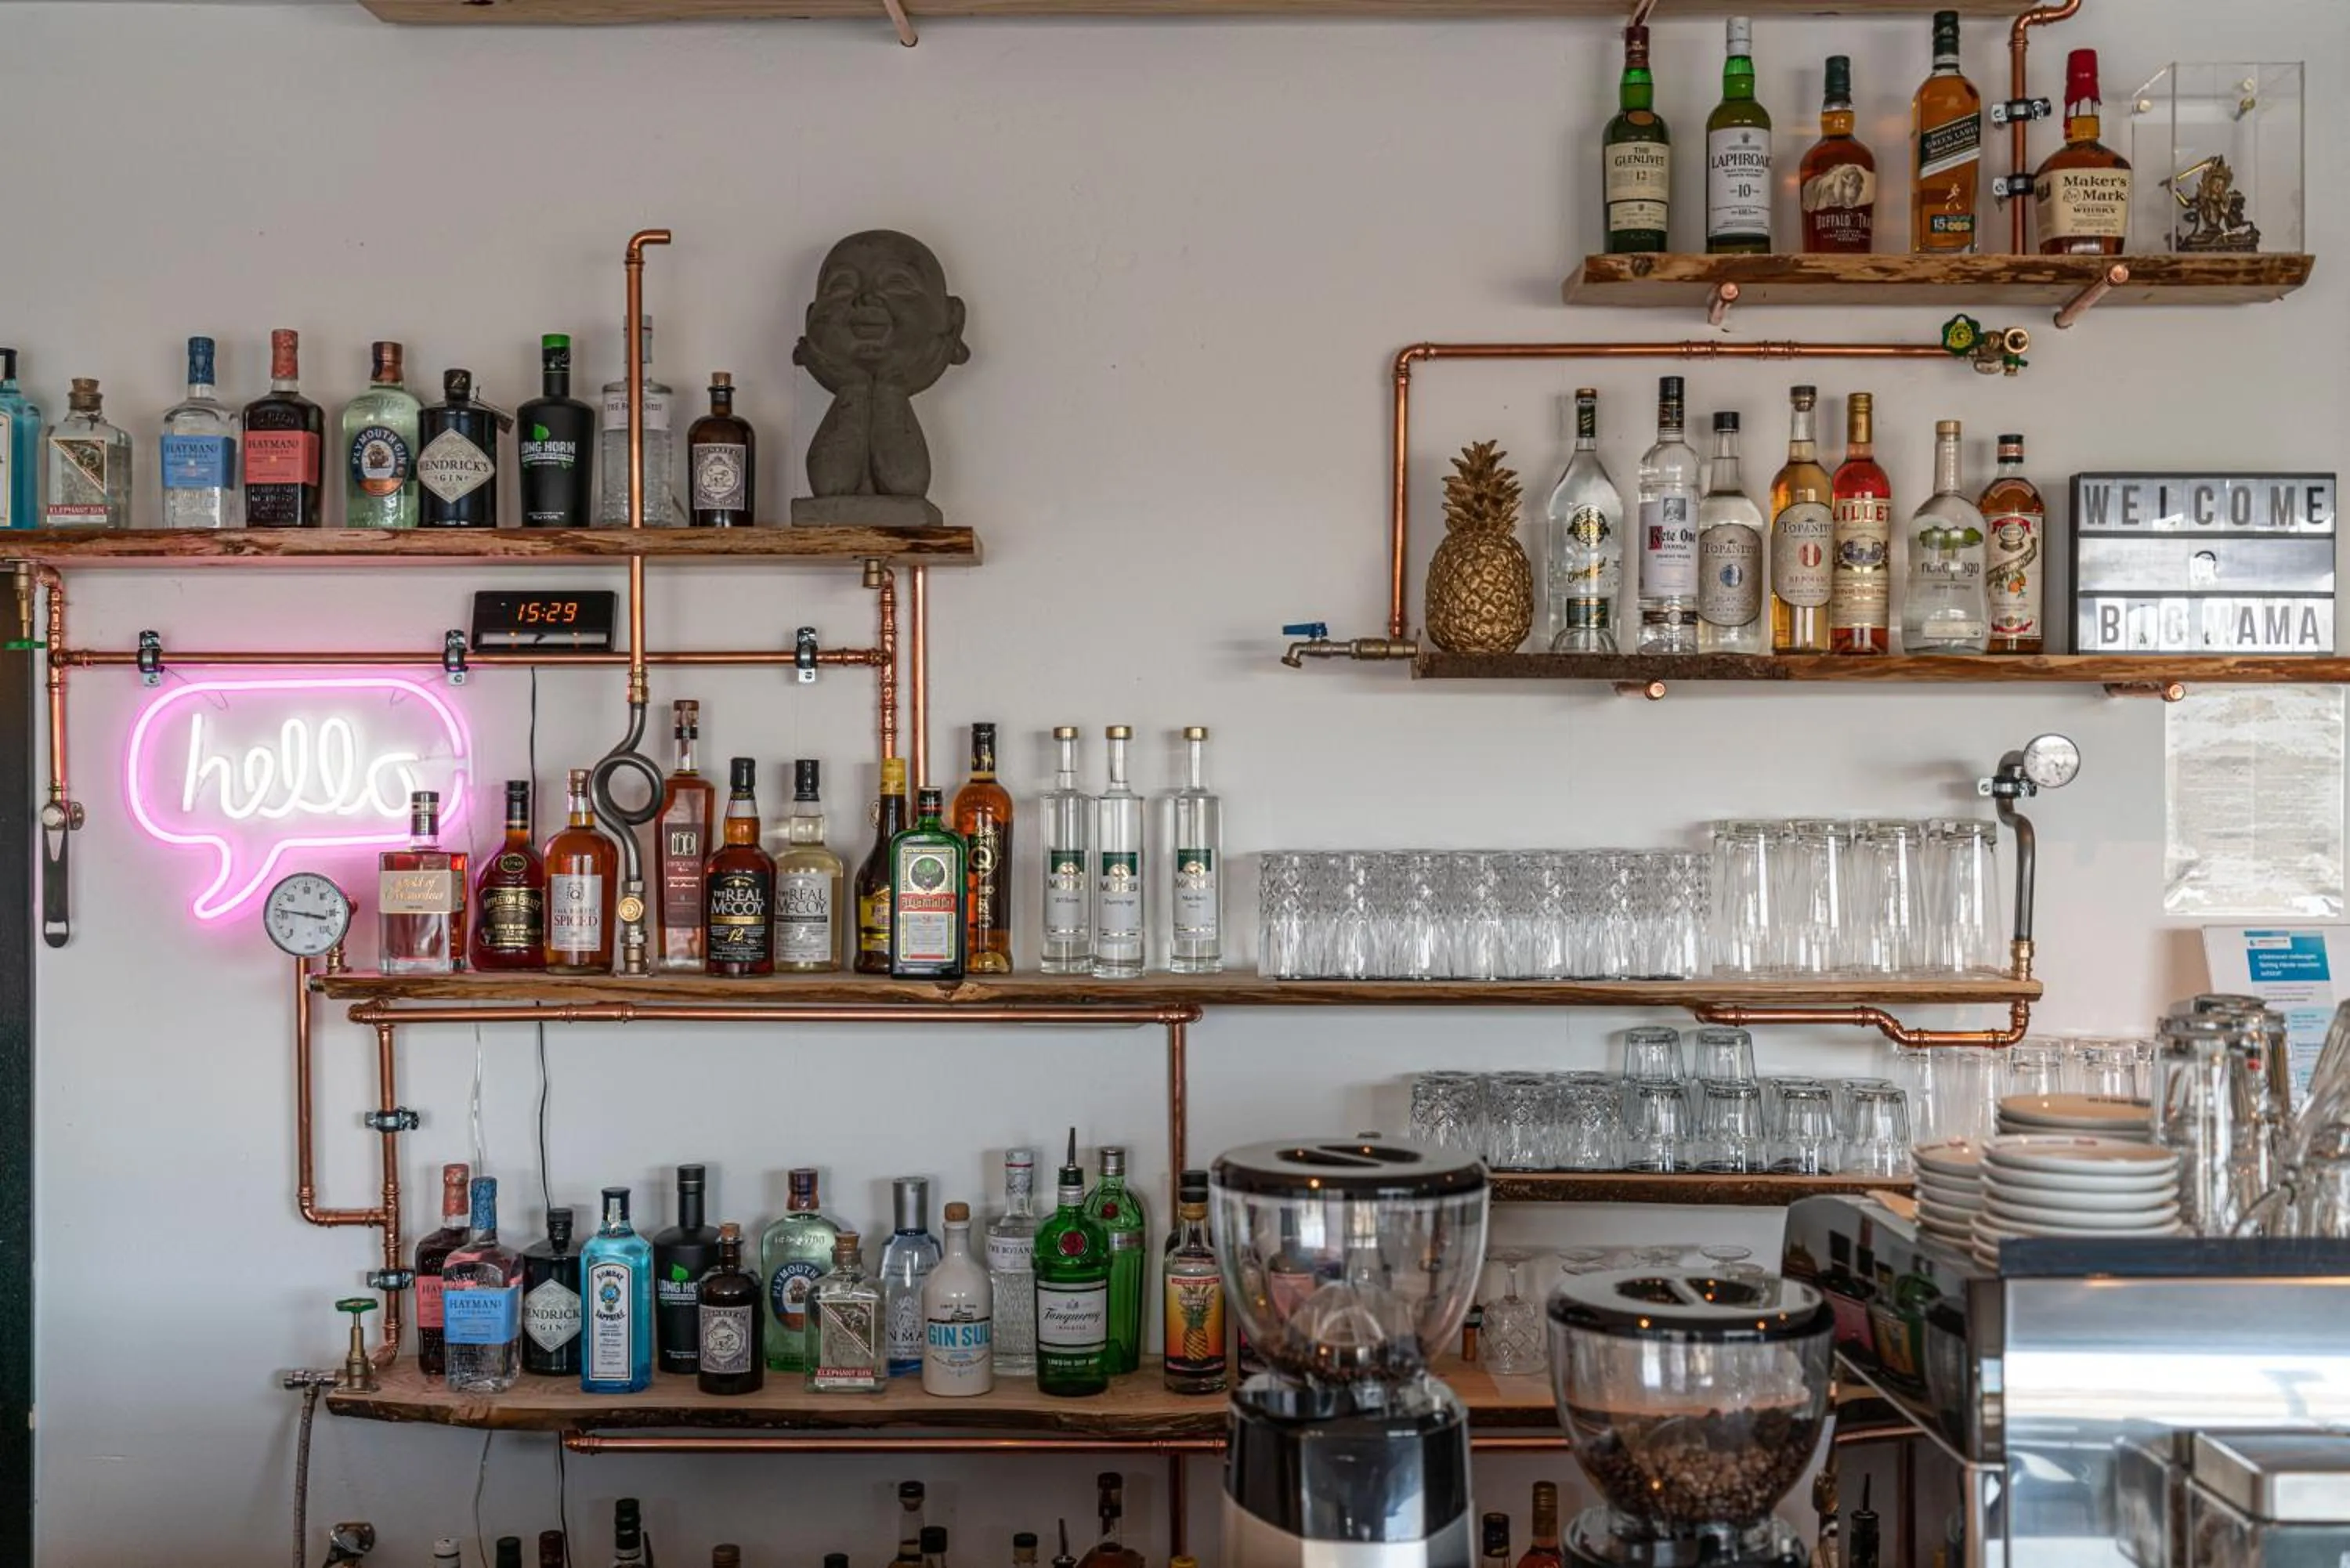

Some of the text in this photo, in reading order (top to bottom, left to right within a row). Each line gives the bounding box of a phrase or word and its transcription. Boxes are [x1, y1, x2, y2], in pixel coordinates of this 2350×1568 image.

[1614, 155, 1665, 167] GLENLIVET
[1636, 172, 1647, 181] 12
[2063, 175, 2128, 188] Maker's
[1737, 184, 1752, 198] 10
[2082, 190, 2127, 201] Mark
[1933, 219, 1946, 231] 15
[352, 428, 407, 464] PLYMOUTH GIN
[544, 441, 576, 453] HORN
[1832, 504, 1891, 522] LILLET
[518, 602, 578, 623] 15:29
[183, 713, 419, 819] hello
[726, 888, 763, 901] REAL
[790, 888, 826, 901] REAL
[728, 927, 745, 942] 12
[772, 1264, 819, 1298] PLYMOUTH
[927, 1324, 956, 1348] GIN
